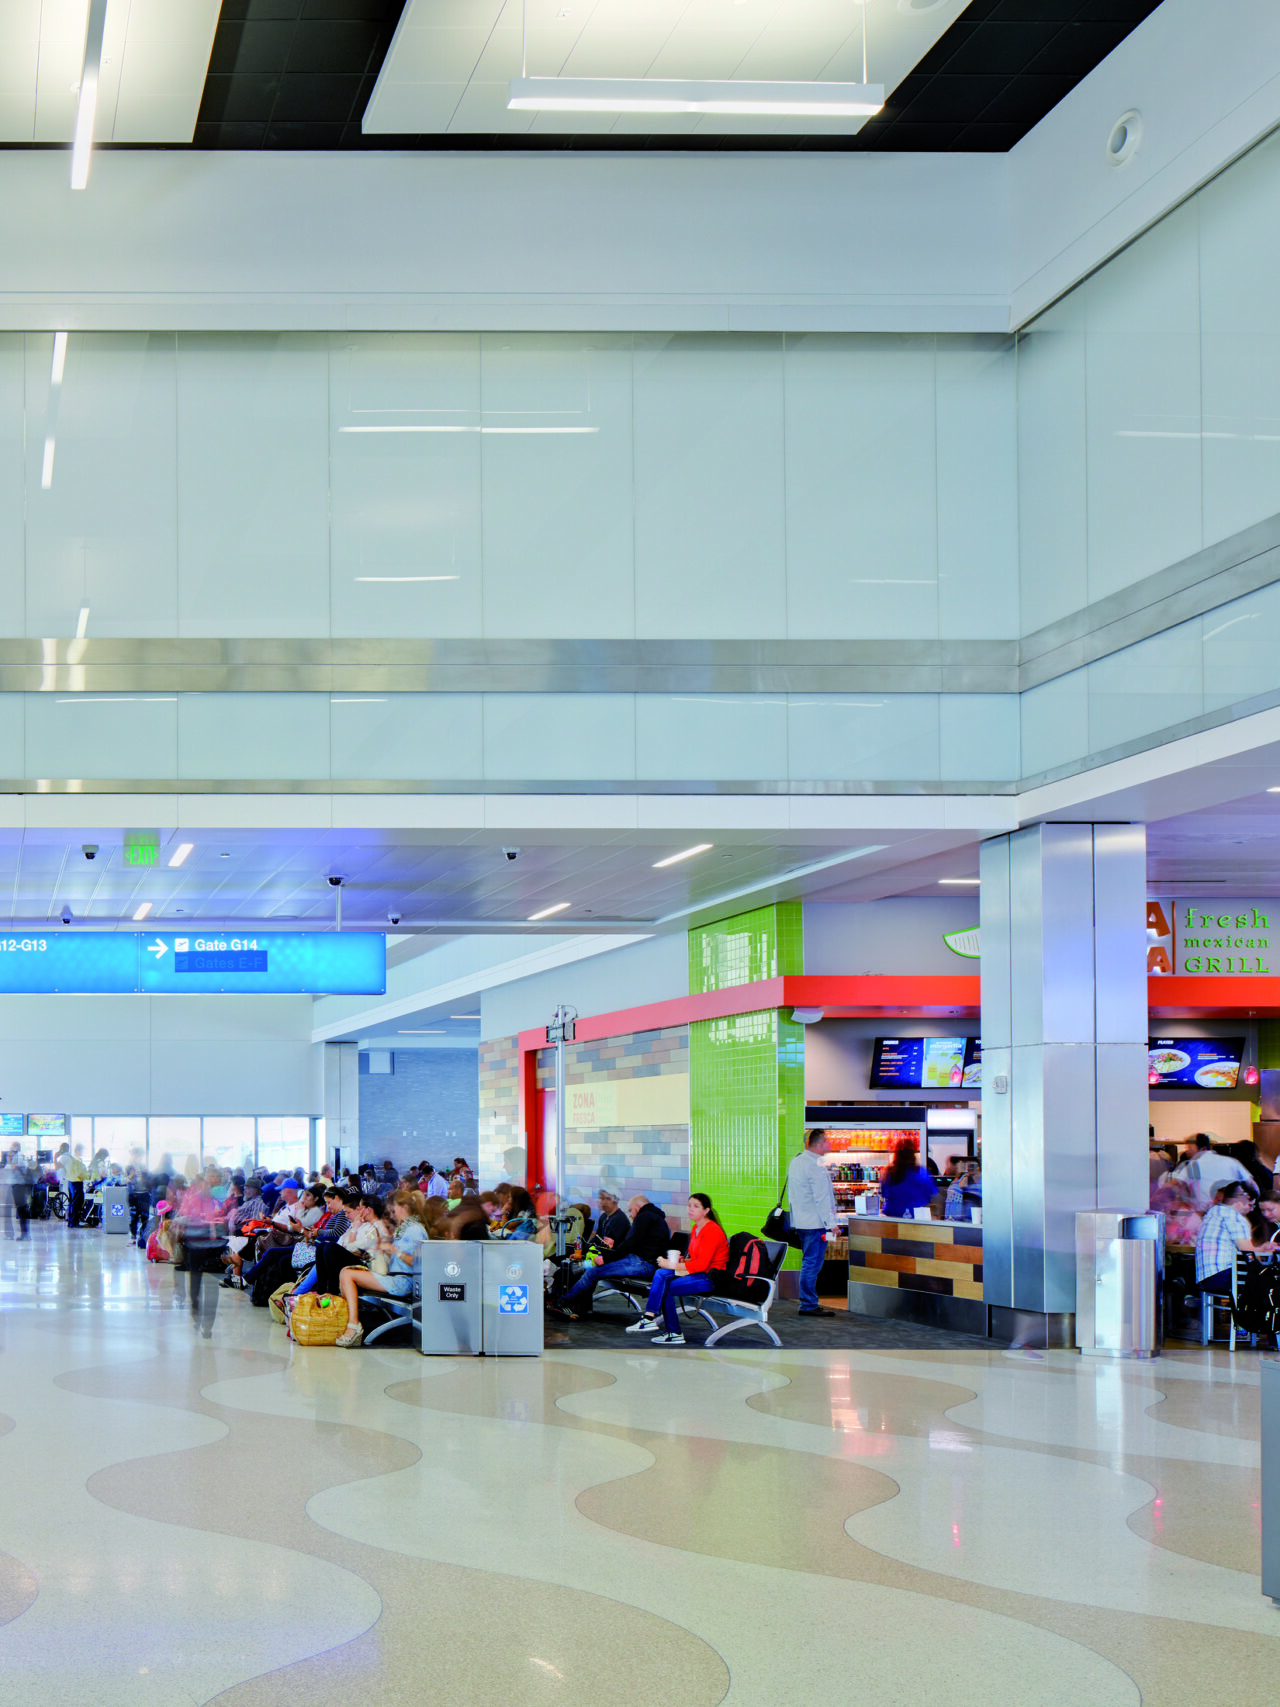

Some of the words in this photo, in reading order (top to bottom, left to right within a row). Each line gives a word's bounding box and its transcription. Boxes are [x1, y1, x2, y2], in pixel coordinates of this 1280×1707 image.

[130, 845, 156, 865] EXIT
[1184, 908, 1270, 928] fresh
[195, 939, 227, 951] Gate
[230, 939, 258, 951] G14
[1184, 935, 1270, 948] mexican
[195, 957, 234, 969] Gates
[1184, 956, 1270, 973] GRILL
[573, 1092, 595, 1109] ZONA
